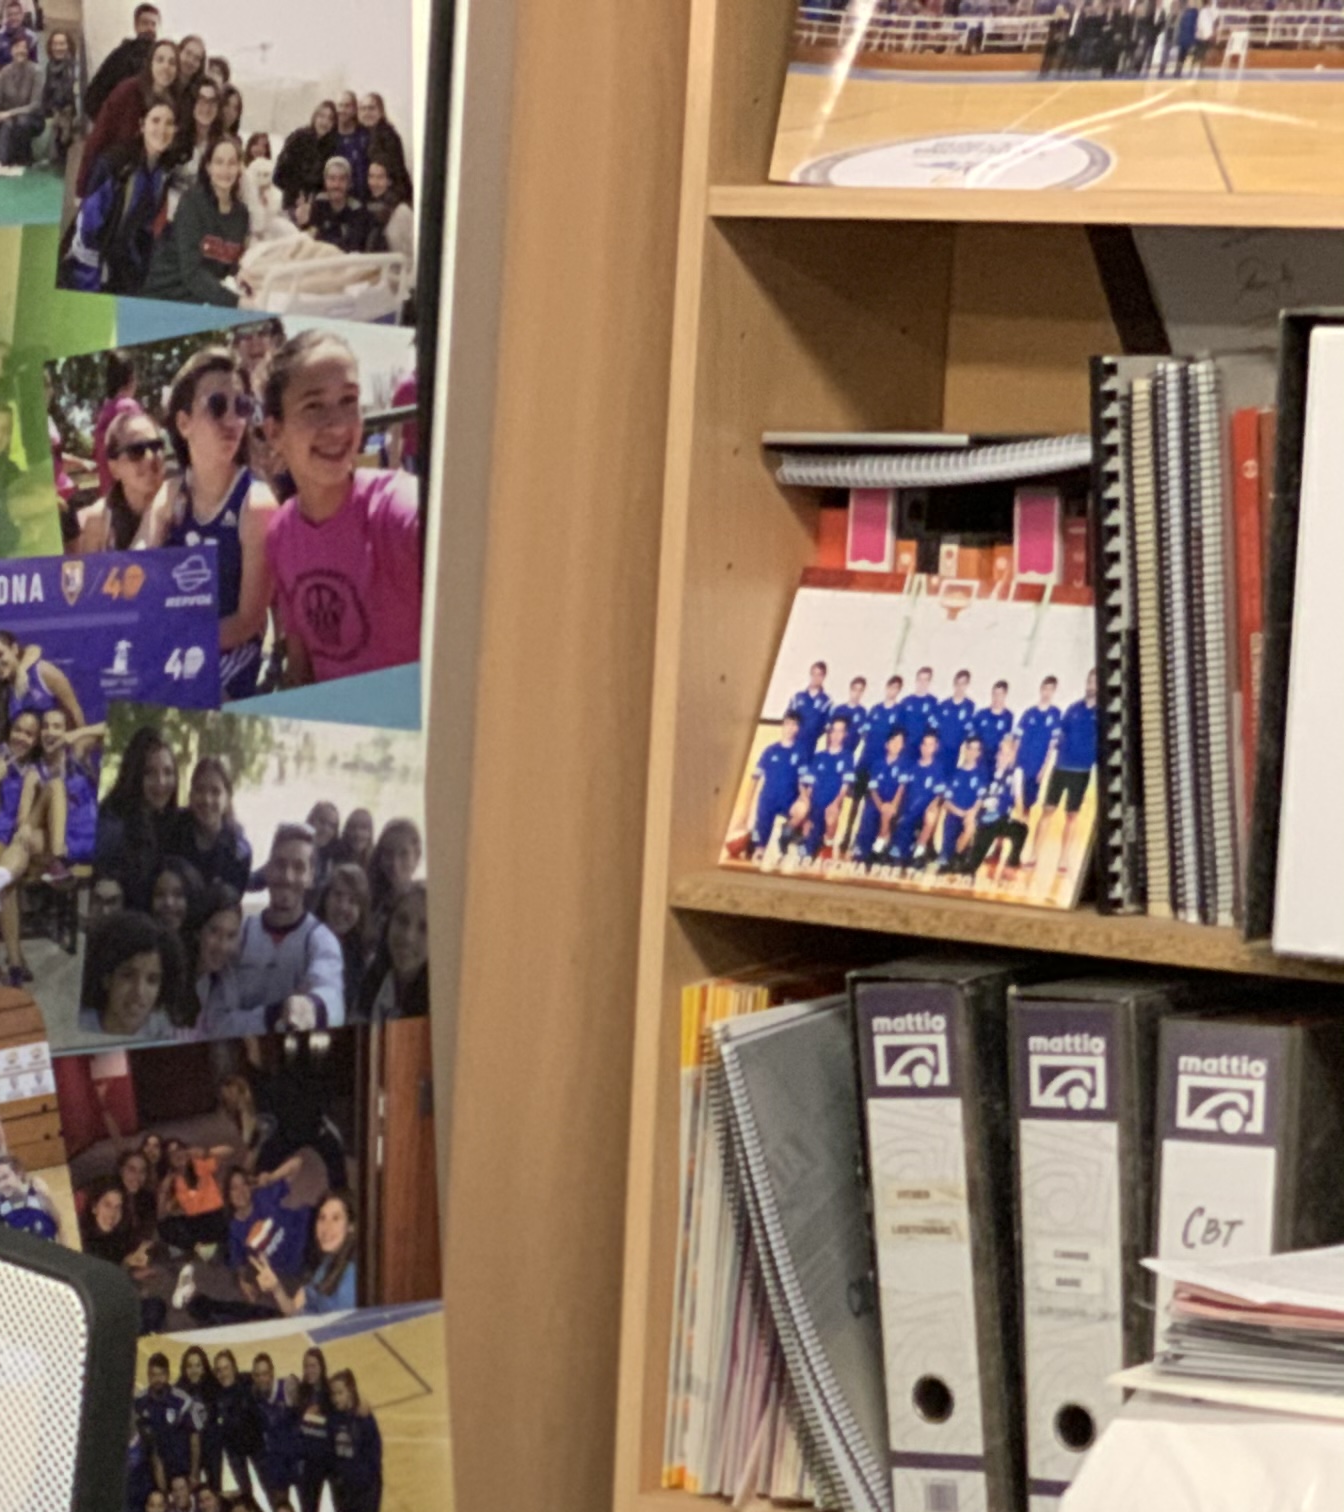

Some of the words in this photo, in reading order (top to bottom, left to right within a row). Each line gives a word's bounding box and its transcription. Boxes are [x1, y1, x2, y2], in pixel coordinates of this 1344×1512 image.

[872, 1011, 946, 1034] mattio
[1028, 1033, 1107, 1056] mattio
[1177, 1055, 1268, 1079] mattio
[1180, 1206, 1244, 1249] CBT
